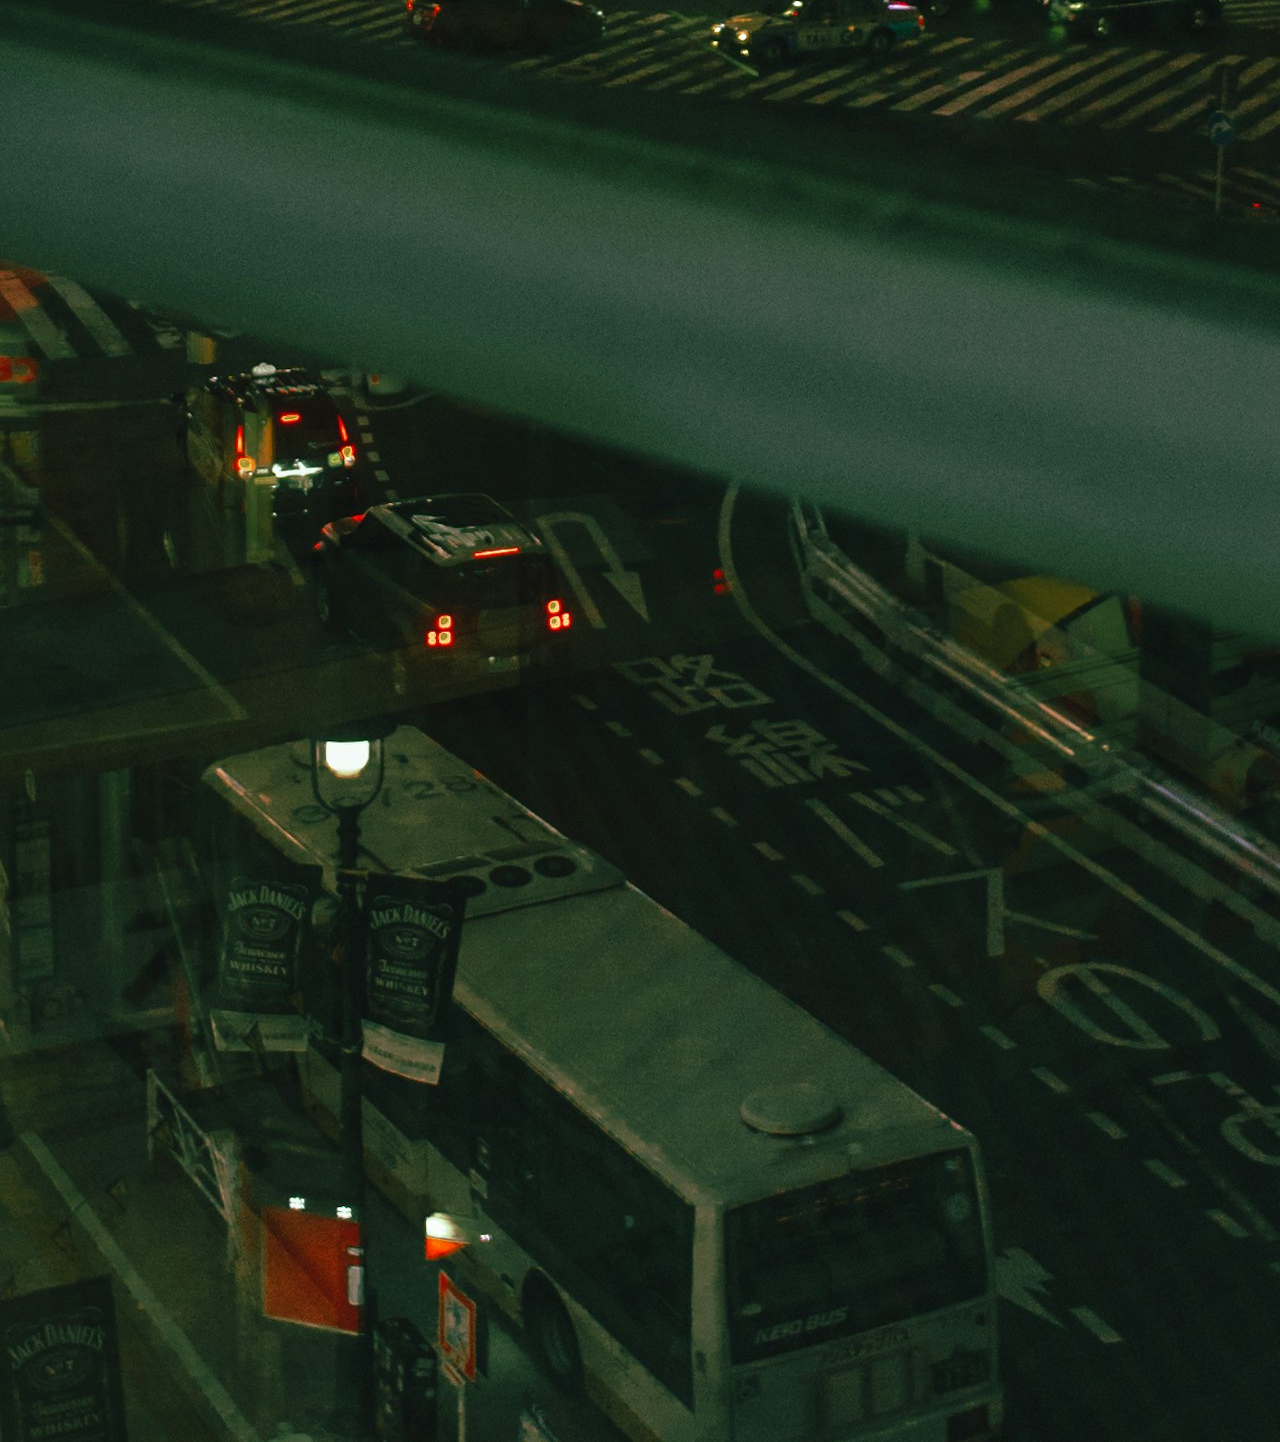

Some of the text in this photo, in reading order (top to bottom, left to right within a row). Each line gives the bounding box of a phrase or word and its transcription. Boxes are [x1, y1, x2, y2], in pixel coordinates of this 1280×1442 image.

[229, 958, 288, 976] WHISKEY
[374, 975, 429, 996] WHISKEY
[803, 1306, 849, 1332] BUS
